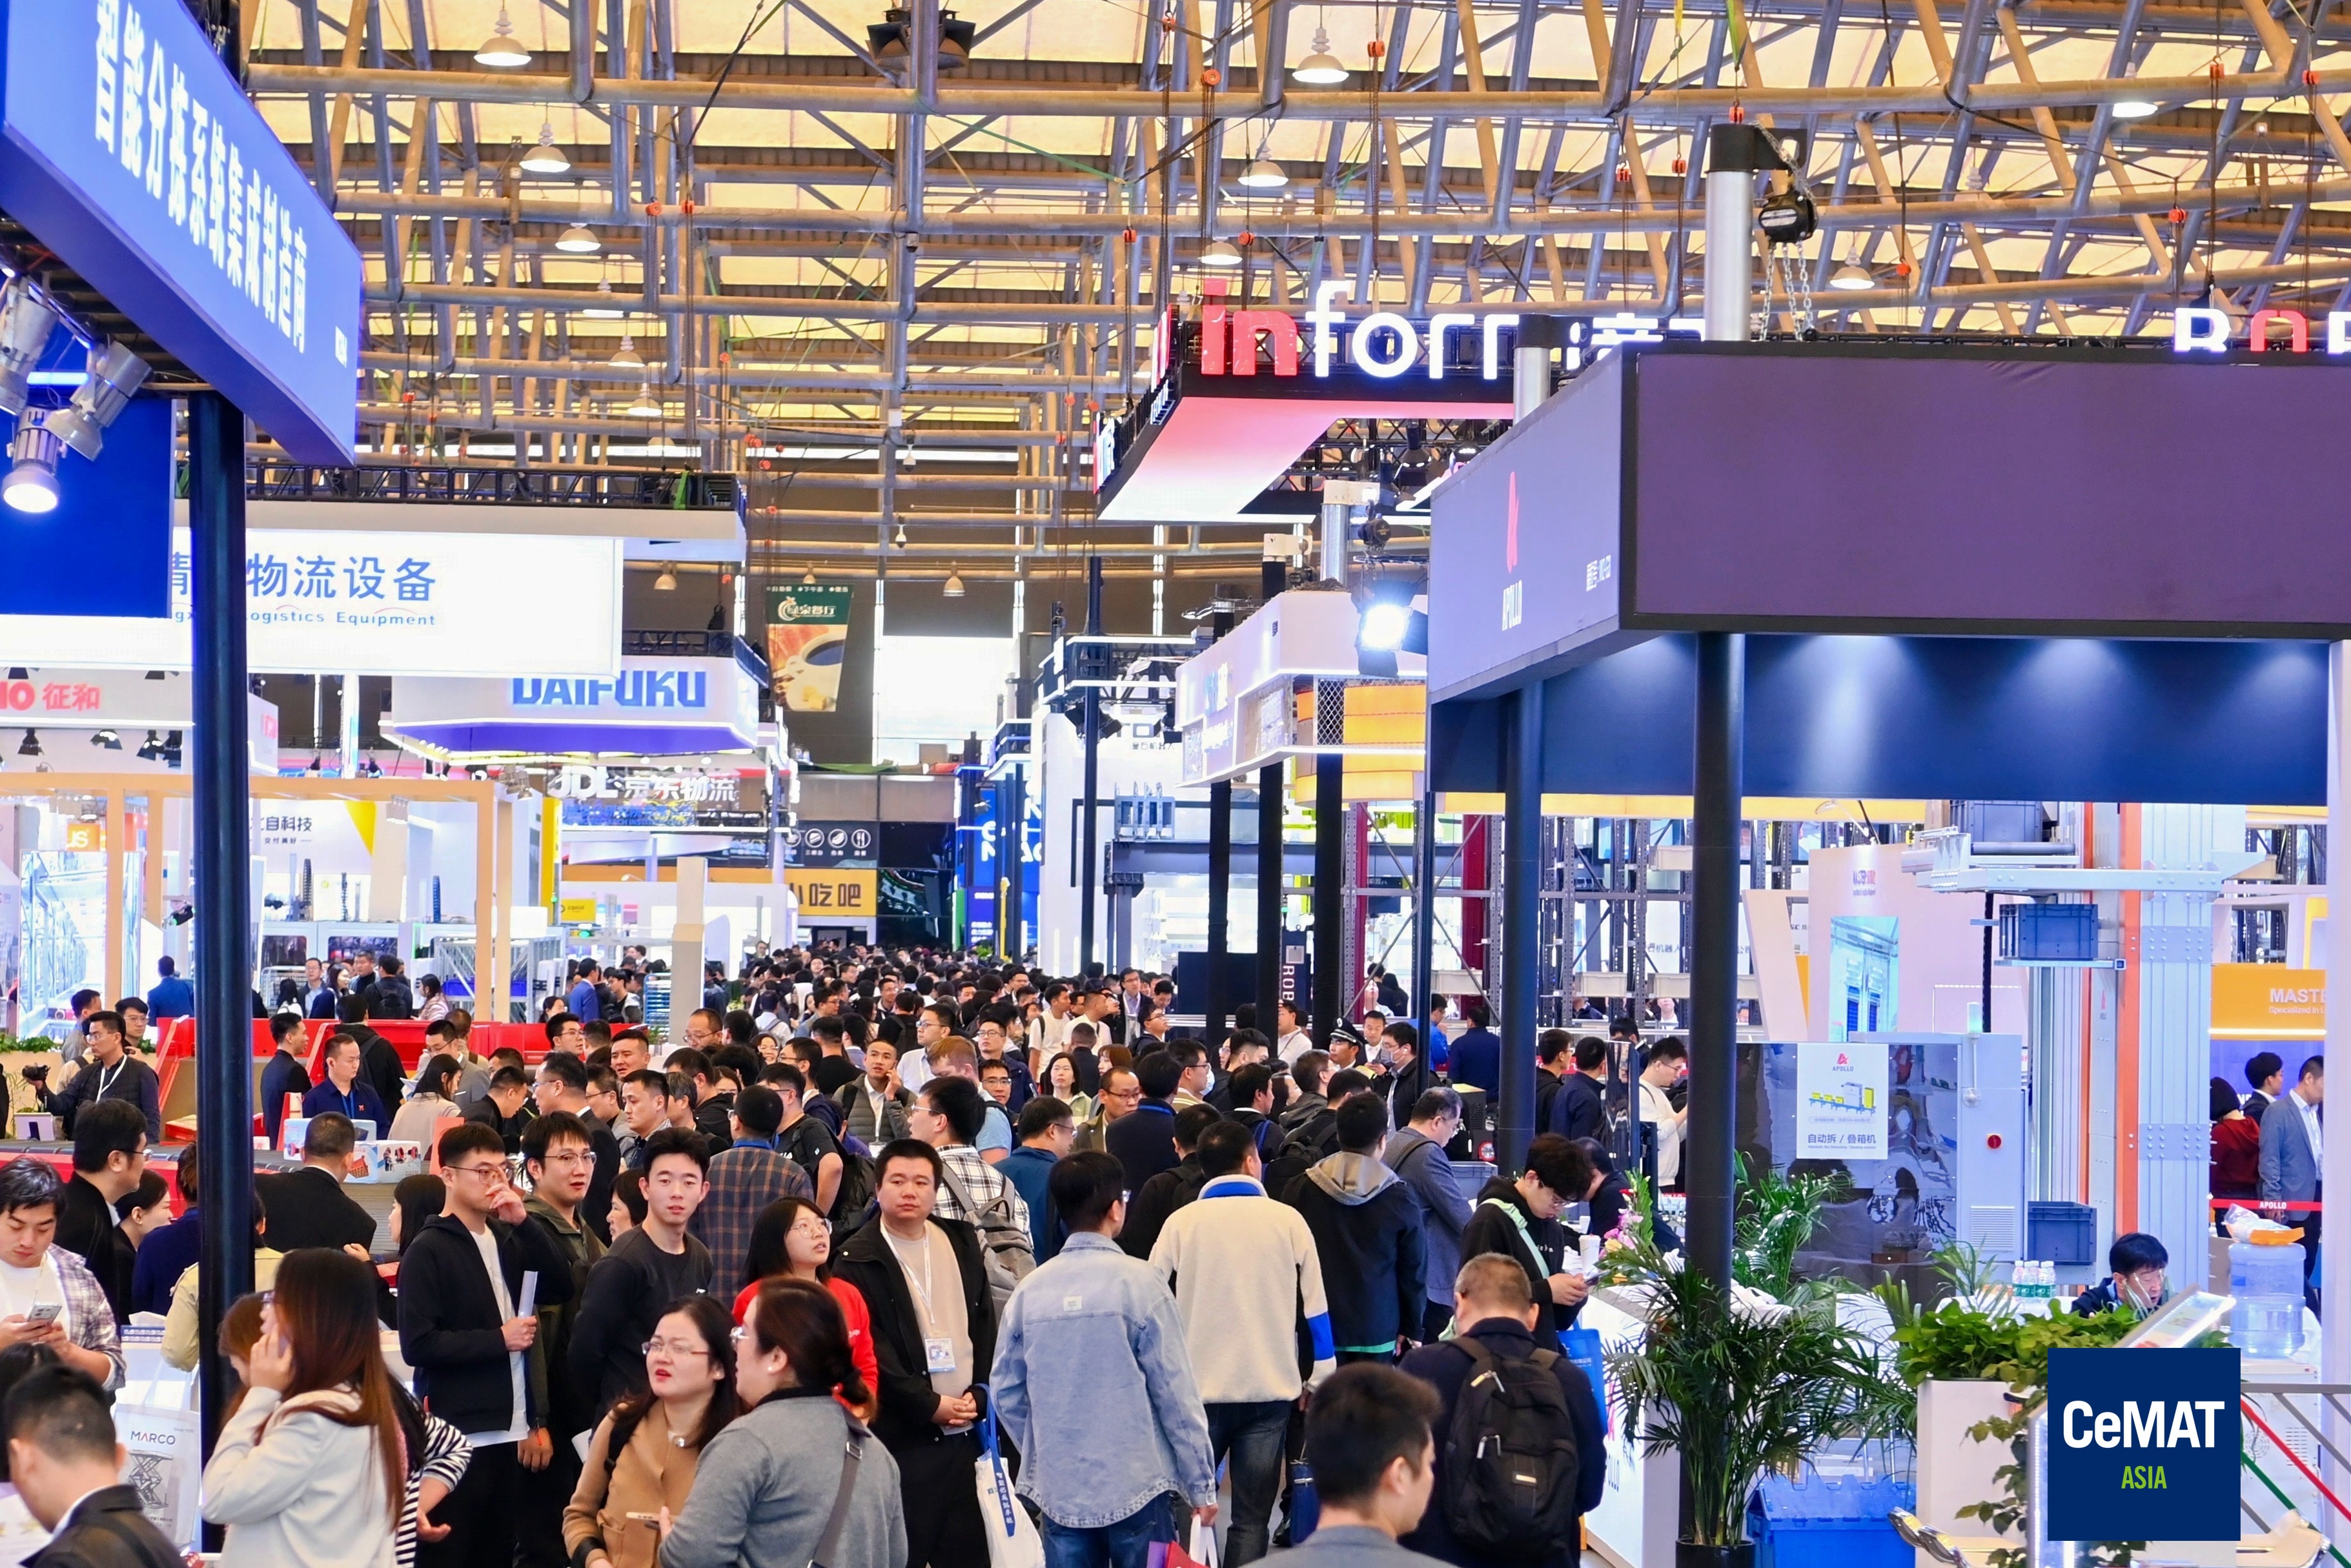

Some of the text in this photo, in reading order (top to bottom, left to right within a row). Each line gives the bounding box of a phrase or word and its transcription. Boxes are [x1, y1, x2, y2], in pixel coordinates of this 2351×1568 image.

[246, 608, 436, 627] ogistics Equipment
[42, 682, 101, 711] 征和
[513, 670, 706, 708] DAIFUKU
[548, 765, 736, 802] JDL 京东物流
[1808, 1134, 1837, 1144] 自动拆
[1847, 1134, 1877, 1144] 叠箱机
[2259, 1201, 2287, 1210] APOLLO
[130, 1431, 176, 1445] MARCO
